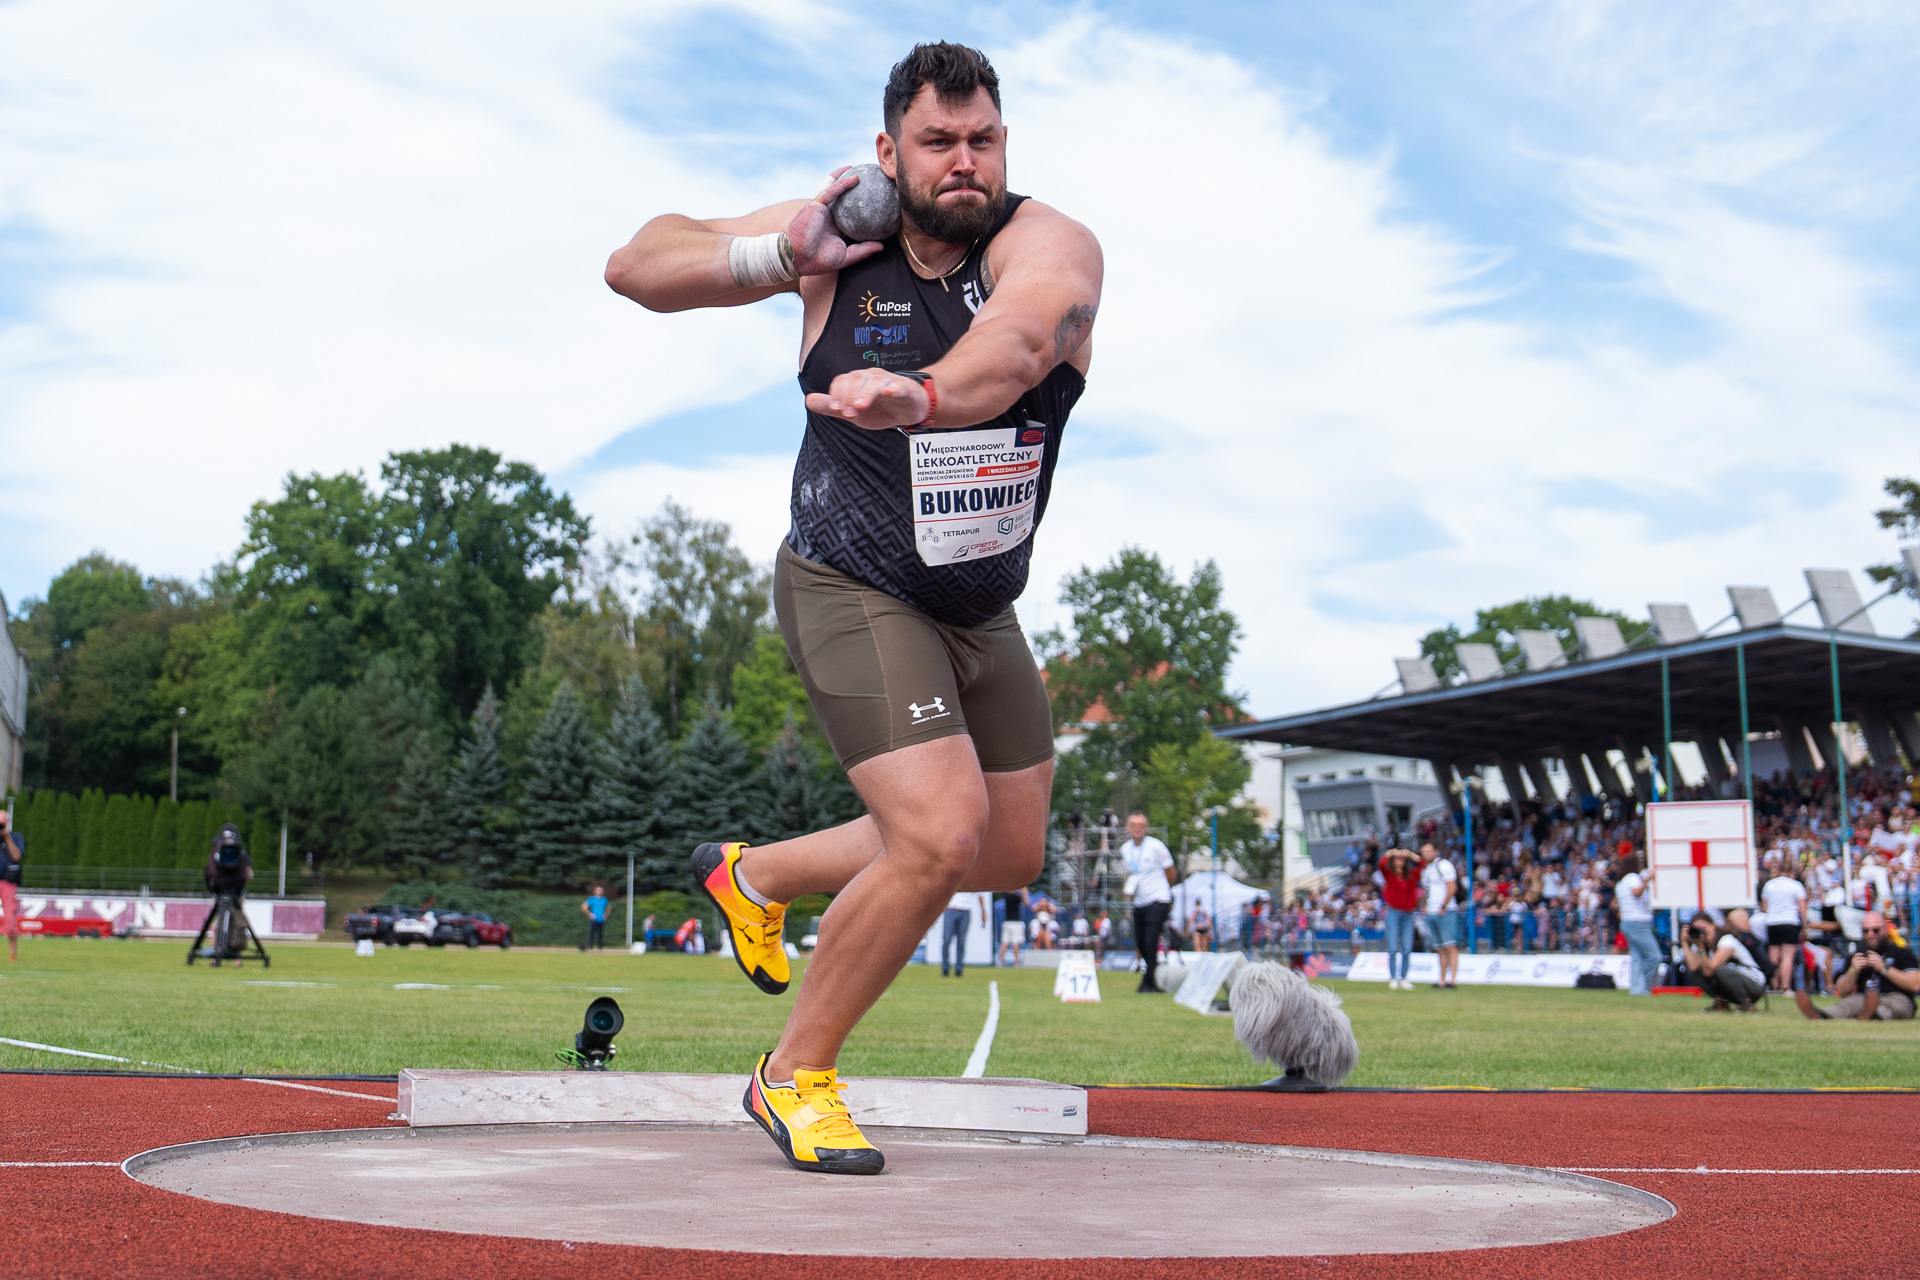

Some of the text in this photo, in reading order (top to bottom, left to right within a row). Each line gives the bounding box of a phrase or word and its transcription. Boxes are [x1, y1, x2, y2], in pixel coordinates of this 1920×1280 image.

[876, 301, 912, 311] InPost
[916, 441, 1006, 455] IV MIĘDZYNARODOWY
[917, 450, 1033, 468] LEKKOATLETYCZNY
[990, 465, 1017, 474] WRZEŚNIA
[917, 473, 975, 481] LUDWICHOWSKIEGO
[942, 528, 980, 537] TETRAPUR
[911, 711, 951, 725] UNDER ARMOUR
[0, 899, 166, 928] ZTYN
[1069, 975, 1092, 993] 17
